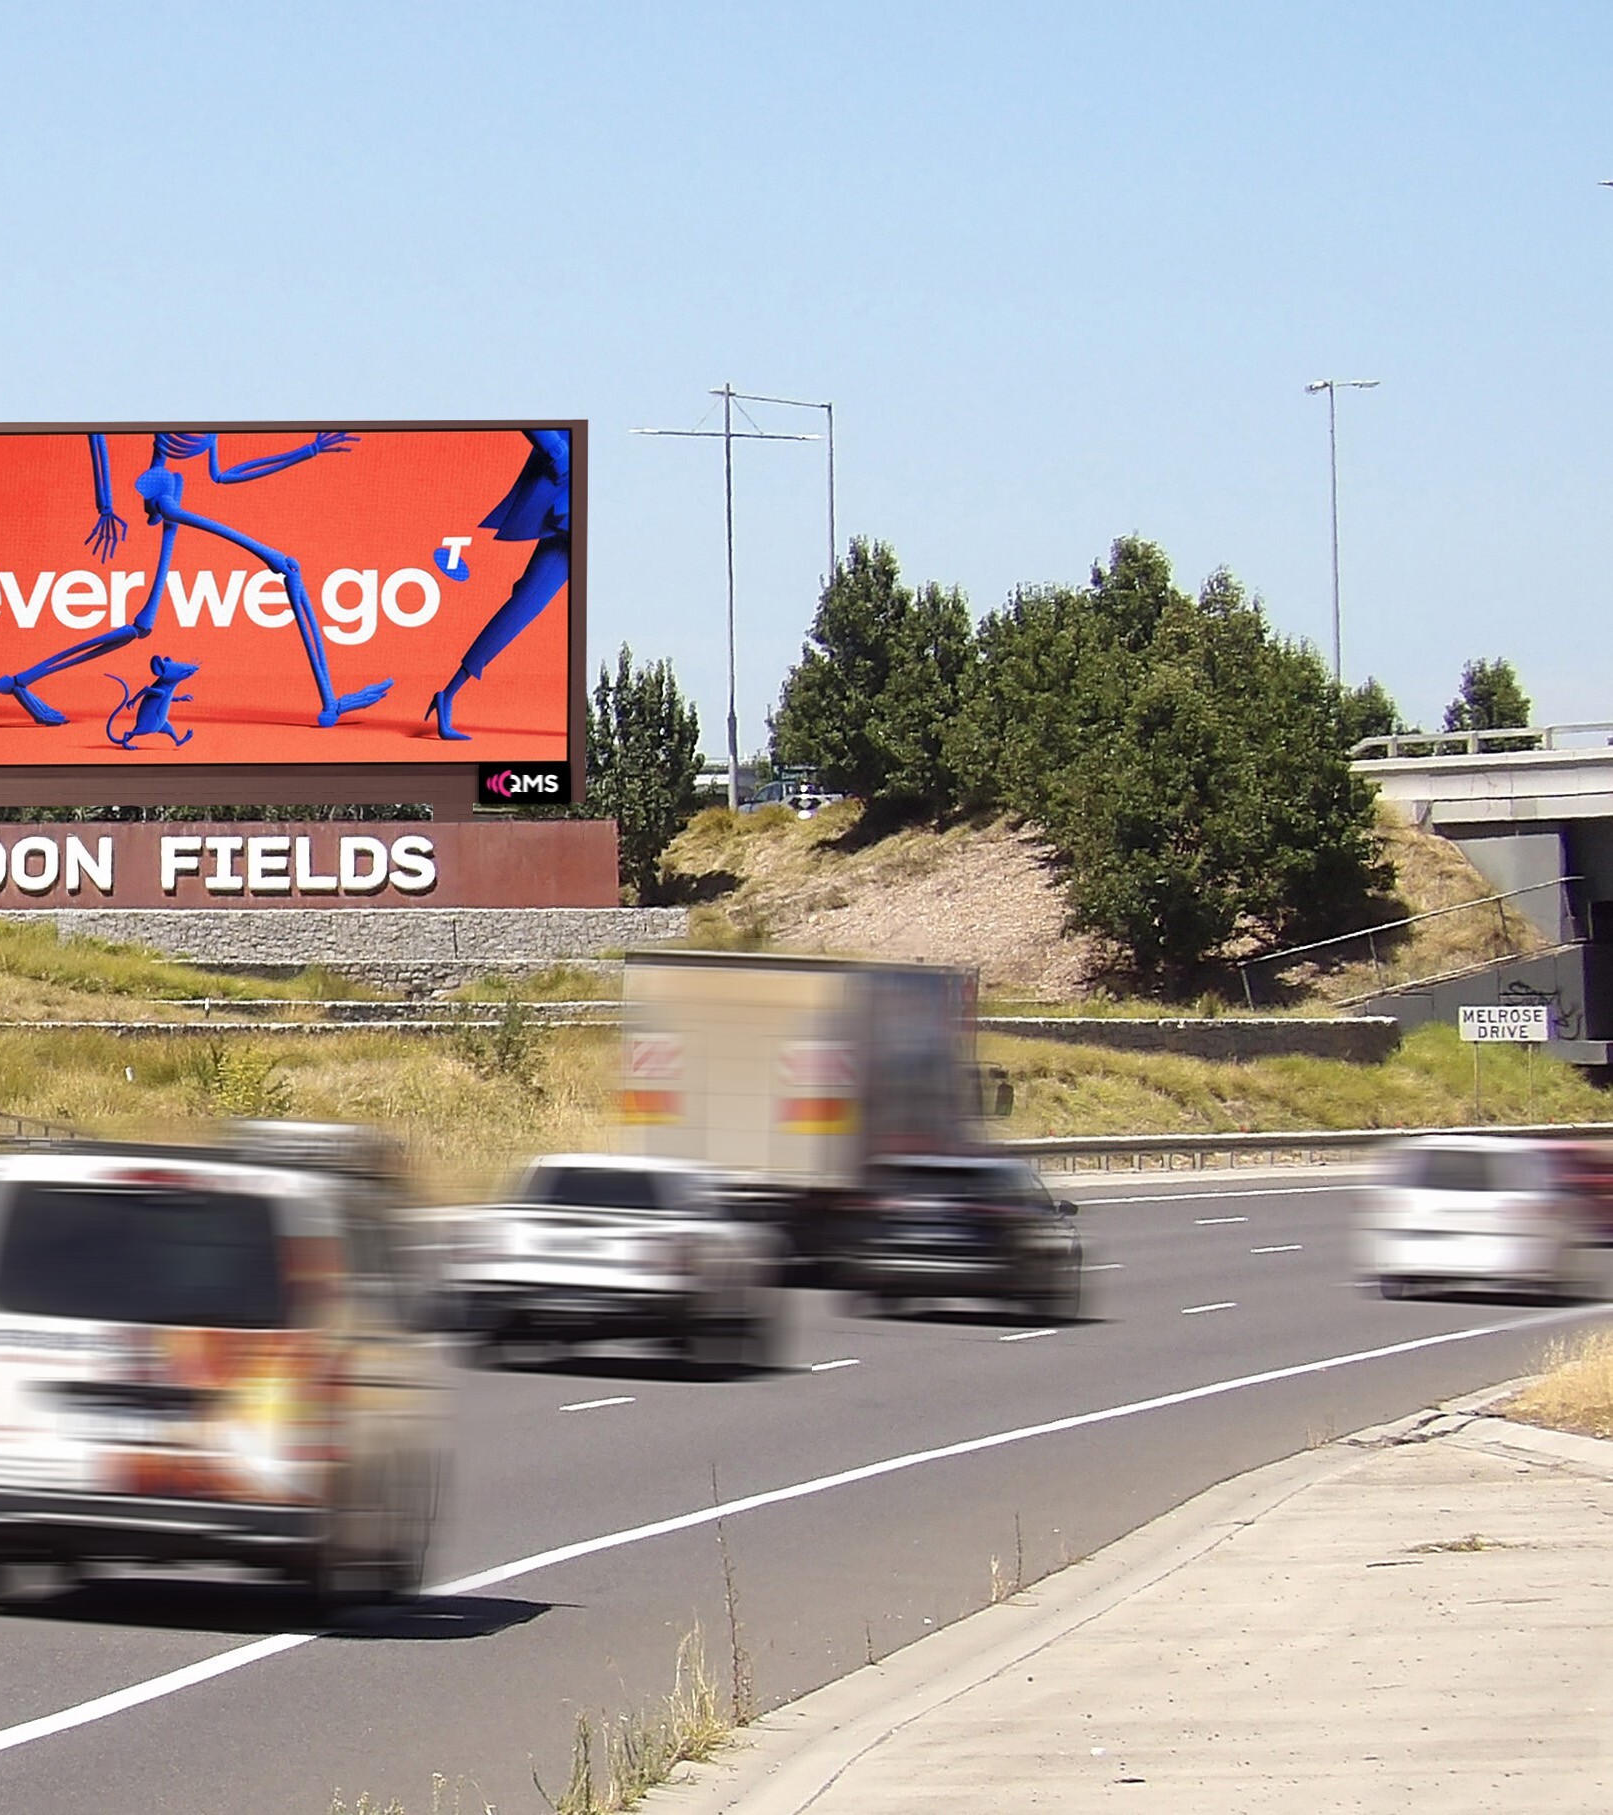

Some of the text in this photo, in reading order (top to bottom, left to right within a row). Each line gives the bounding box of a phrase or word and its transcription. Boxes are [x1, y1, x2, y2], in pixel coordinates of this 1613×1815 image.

[165, 569, 297, 629] we
[322, 568, 441, 645] go
[498, 770, 559, 797] QMS
[160, 835, 438, 896] FIELDS
[1463, 1009, 1544, 1023] MELROSE
[1478, 1026, 1529, 1039] DRIVE
